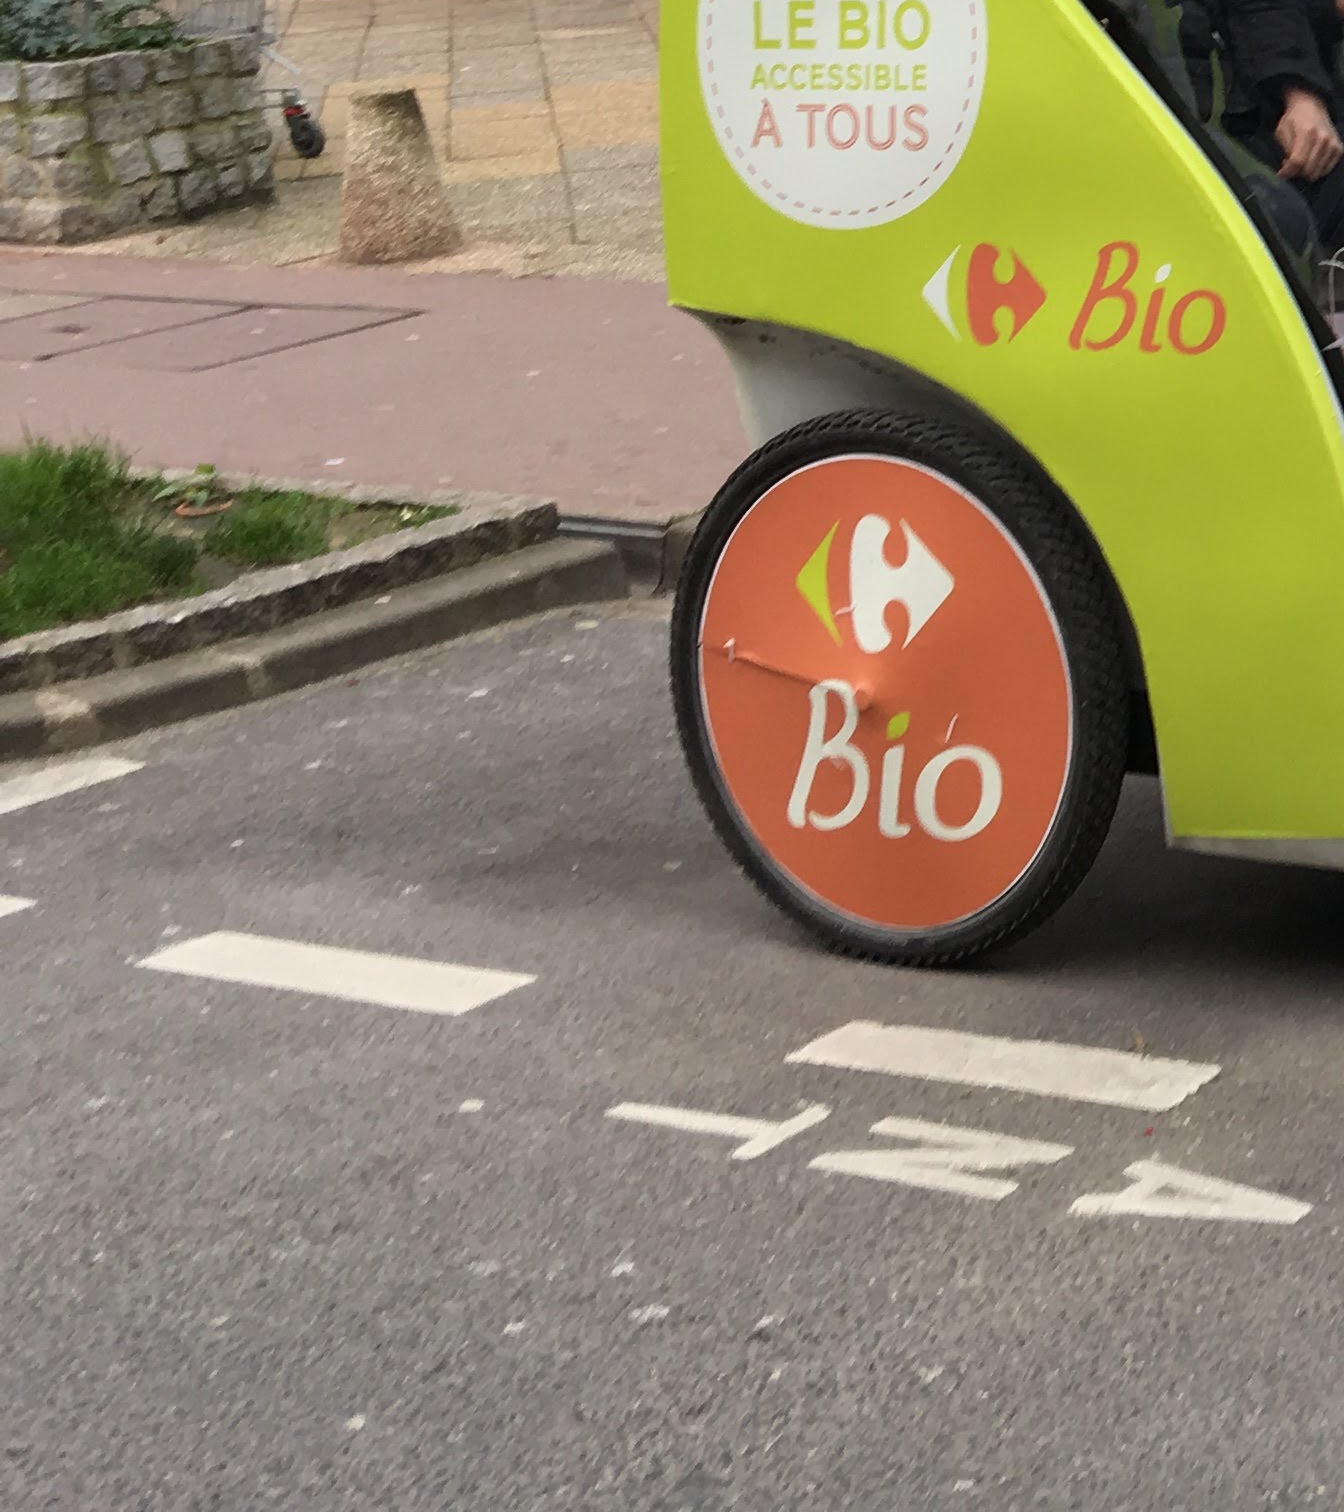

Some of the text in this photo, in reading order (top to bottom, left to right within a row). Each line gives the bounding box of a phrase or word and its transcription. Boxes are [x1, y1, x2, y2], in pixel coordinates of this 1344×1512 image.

[753, 0, 816, 50] LE
[750, 63, 928, 91] ACCESSIBLE
[796, 102, 930, 151] TOUS
[1069, 241, 1226, 355] Bio
[787, 678, 1003, 842] Bio
